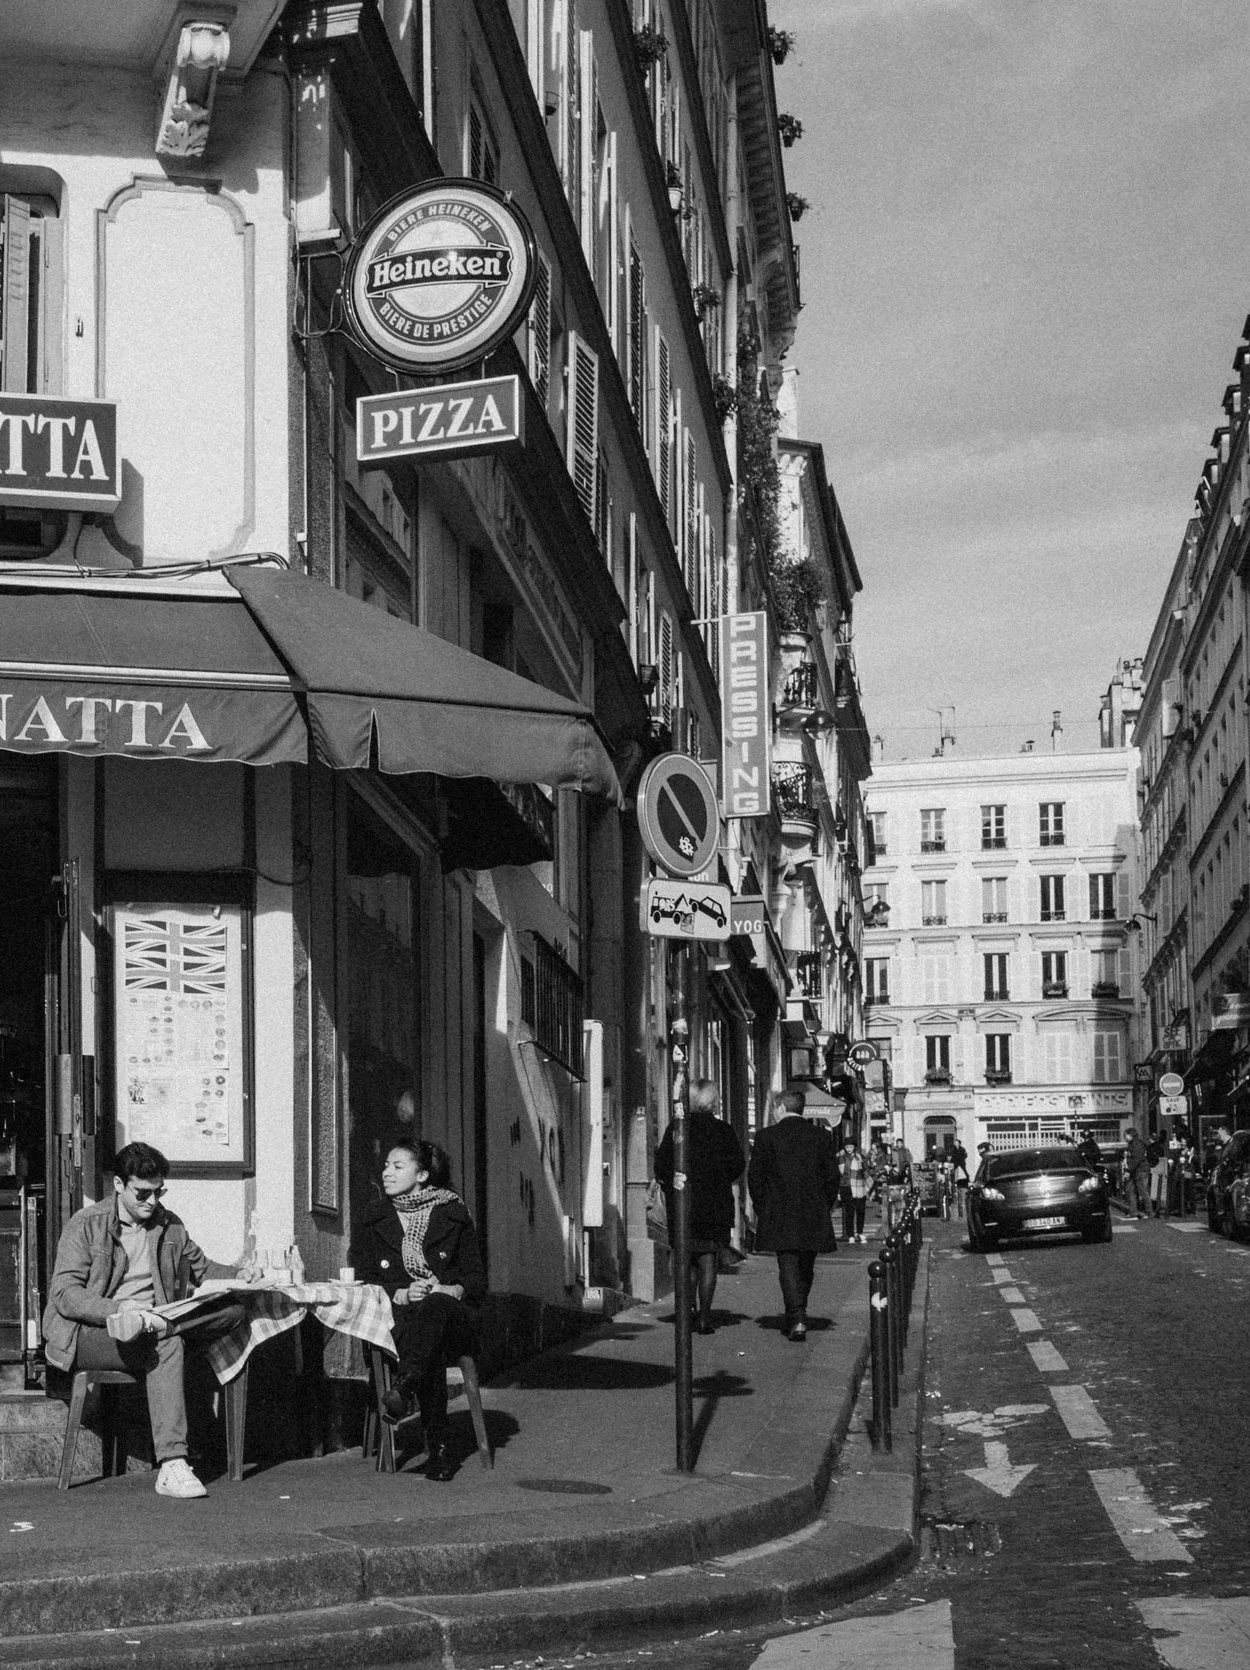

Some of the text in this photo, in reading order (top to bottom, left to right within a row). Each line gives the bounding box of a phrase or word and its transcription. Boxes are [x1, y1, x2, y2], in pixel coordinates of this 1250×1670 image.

[427, 202, 493, 233] HEINEKEN
[378, 293, 493, 339] BIERE DE PRESTIGE
[369, 393, 507, 449] PIZZA
[729, 614, 760, 814] PRESSING
